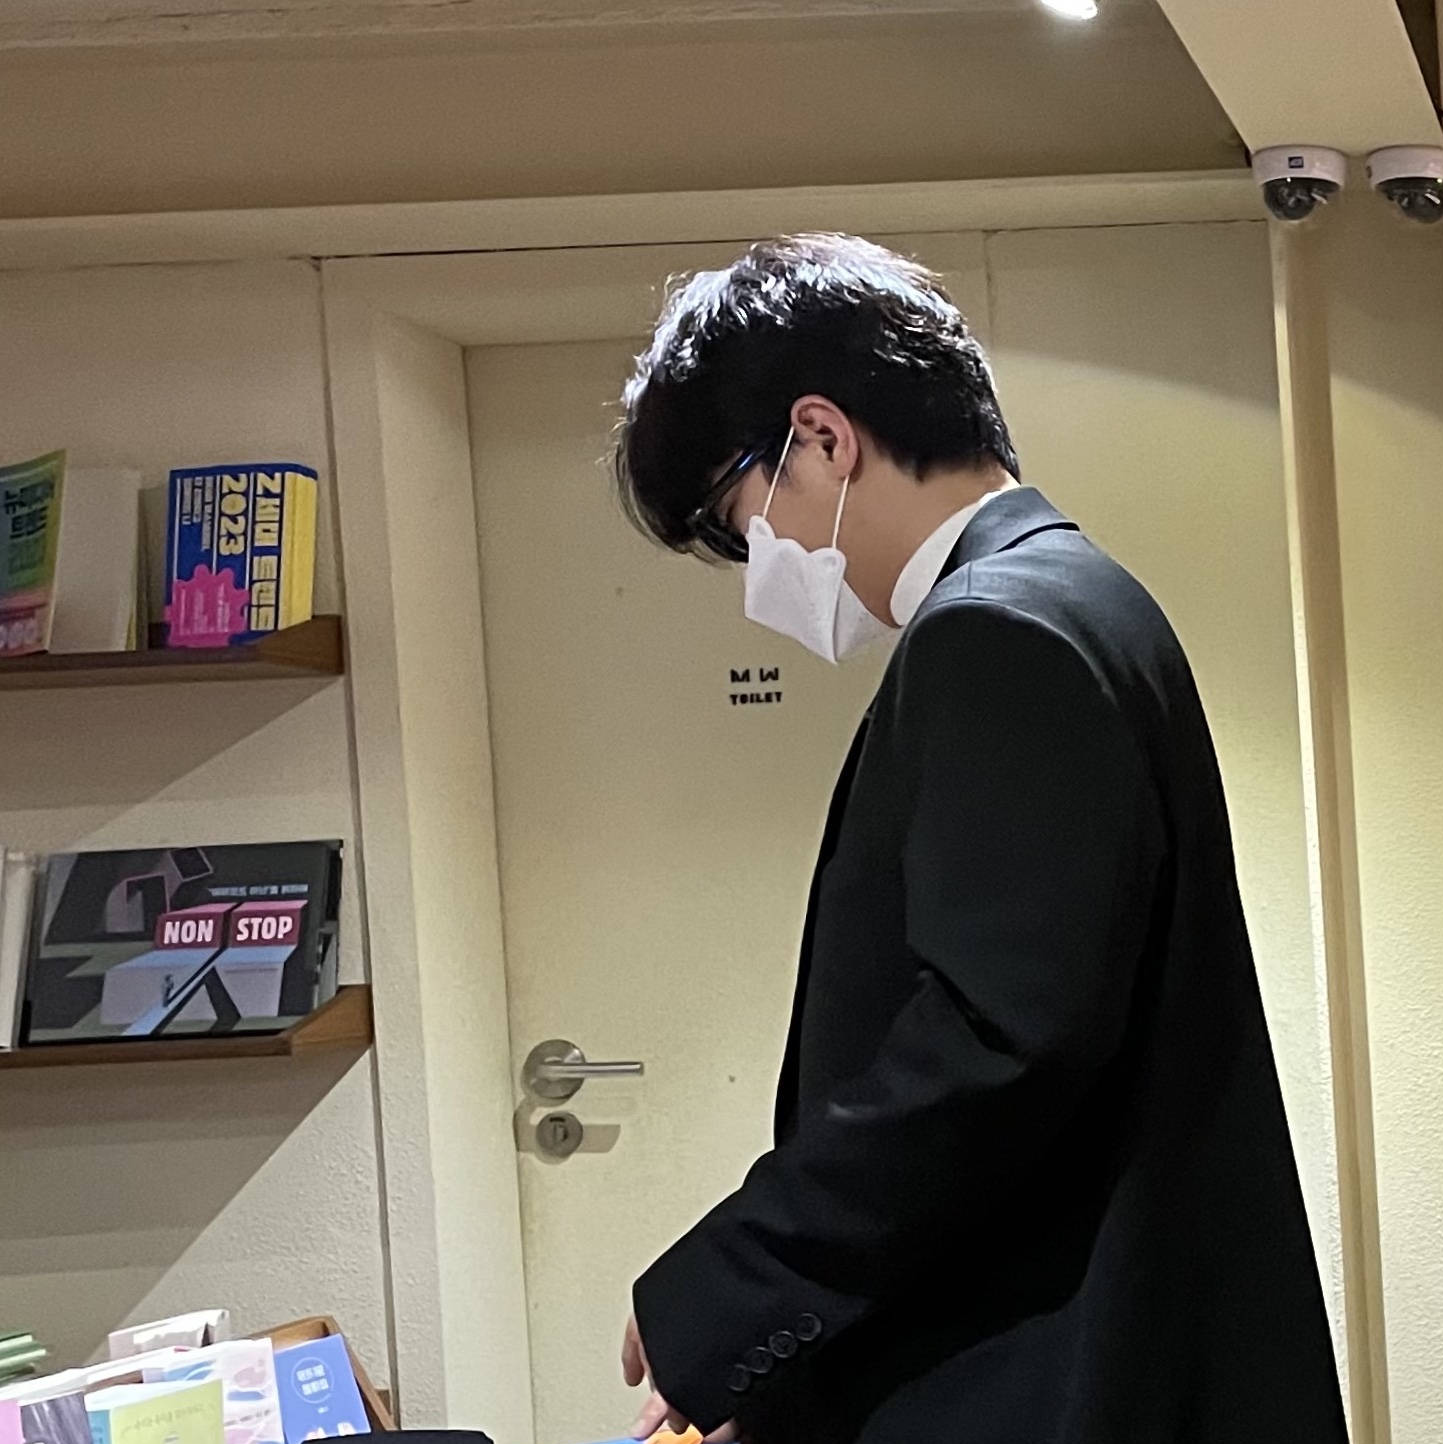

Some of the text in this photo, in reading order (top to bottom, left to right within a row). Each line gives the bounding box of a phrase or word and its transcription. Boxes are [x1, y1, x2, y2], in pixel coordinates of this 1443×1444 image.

[219, 473, 249, 556] 2023
[730, 667, 779, 683] M W
[730, 691, 782, 705] TOILET
[163, 916, 293, 945] NON STOP
